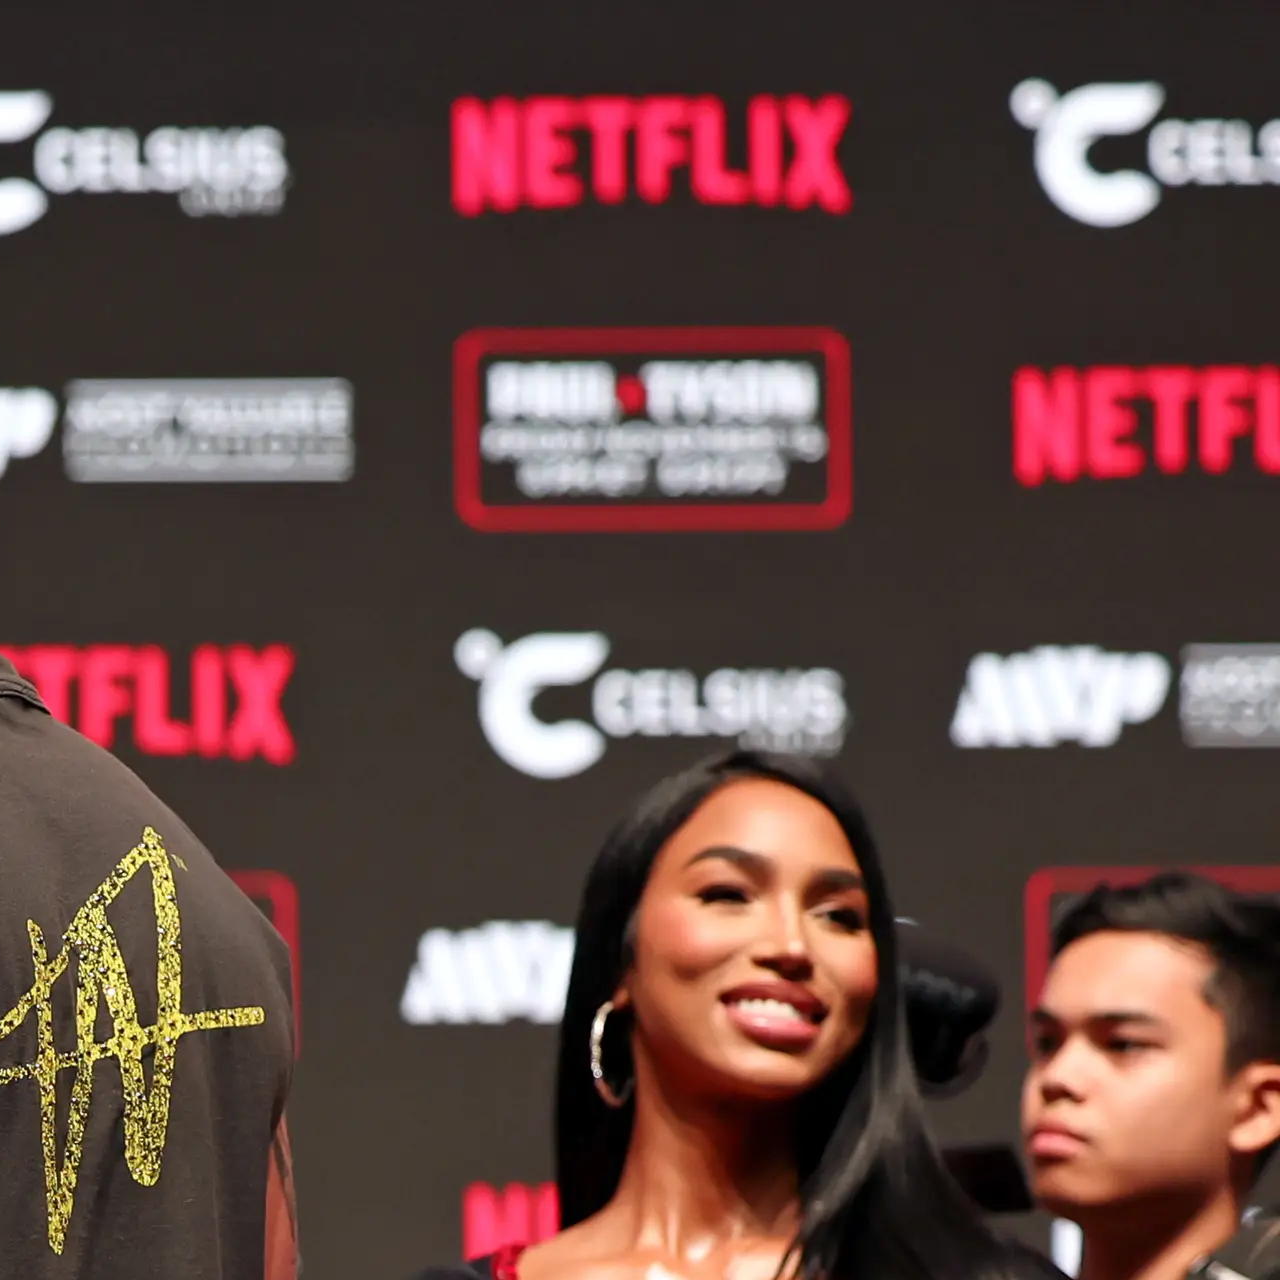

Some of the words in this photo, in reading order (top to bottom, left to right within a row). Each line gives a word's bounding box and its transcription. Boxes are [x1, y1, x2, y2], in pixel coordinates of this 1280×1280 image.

[34, 125, 288, 192] CELSIUS
[451, 94, 852, 217] NETFLIX
[593, 667, 847, 736] CELSIUS
